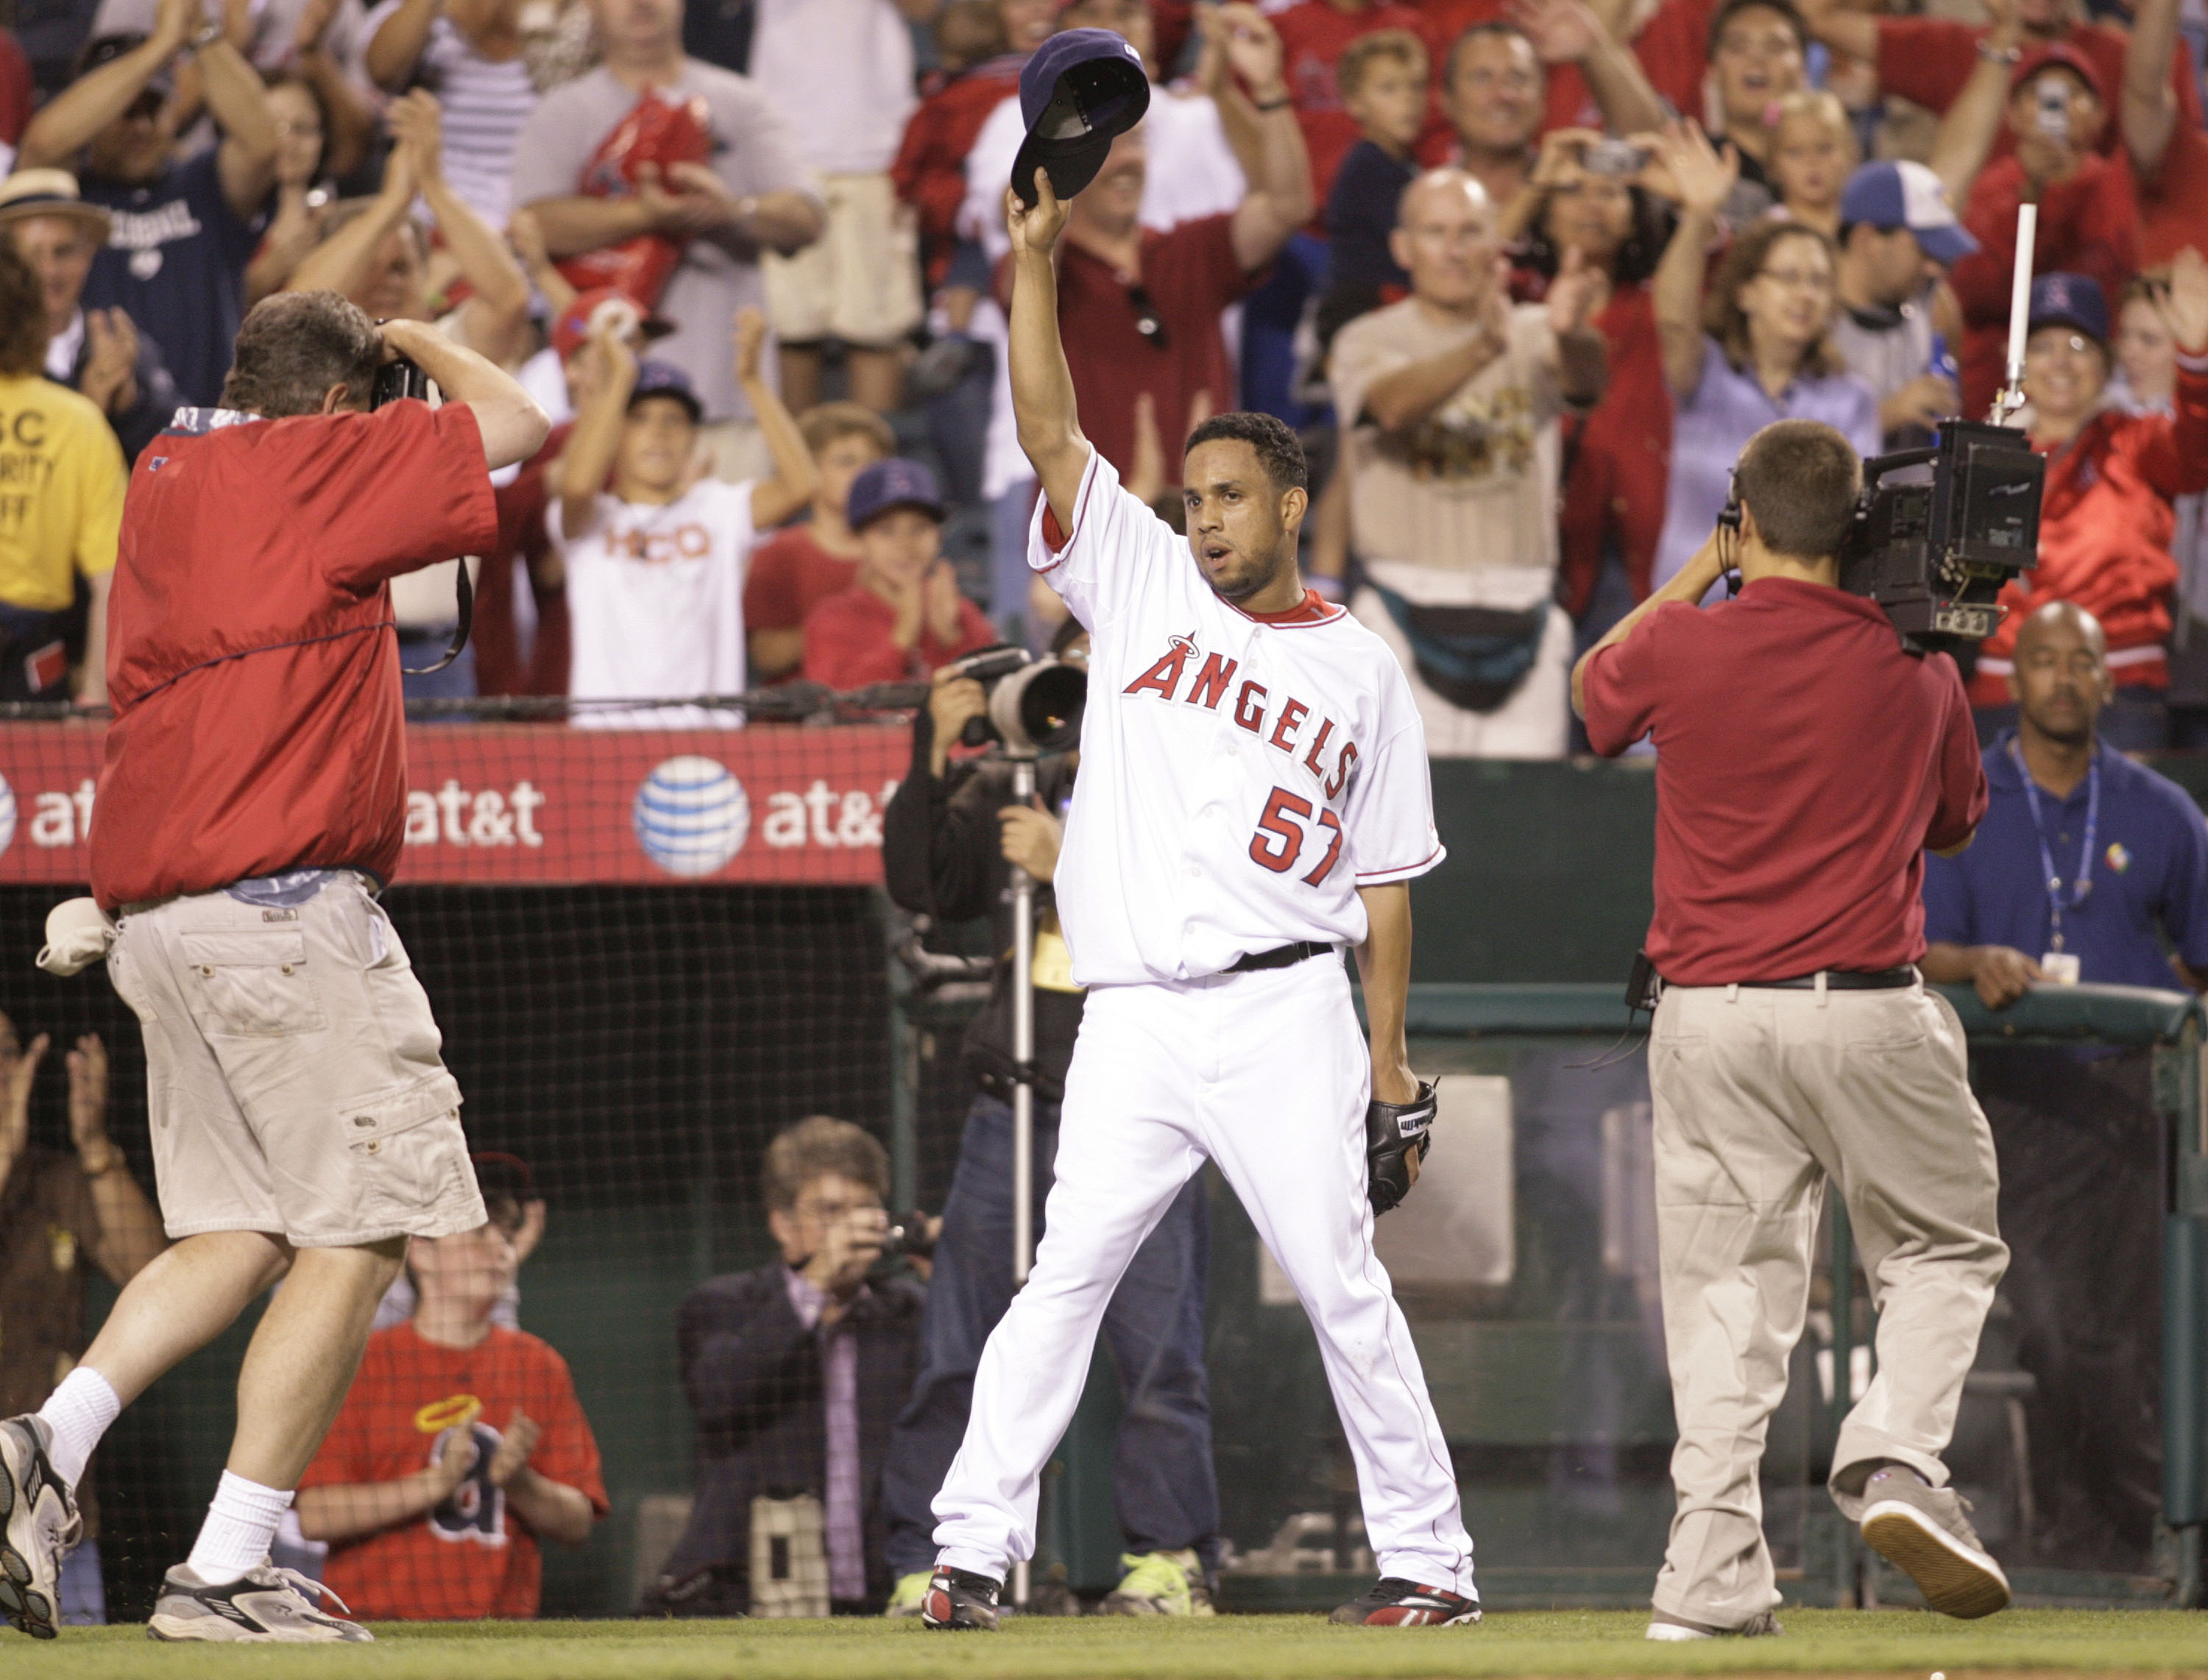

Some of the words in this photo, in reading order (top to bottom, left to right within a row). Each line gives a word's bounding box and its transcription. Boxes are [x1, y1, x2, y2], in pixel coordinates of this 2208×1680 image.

[1121, 630, 1359, 801] ANGELS
[403, 779, 545, 848] at&t
[762, 779, 899, 848] at&
[1248, 785, 1343, 888] 57
